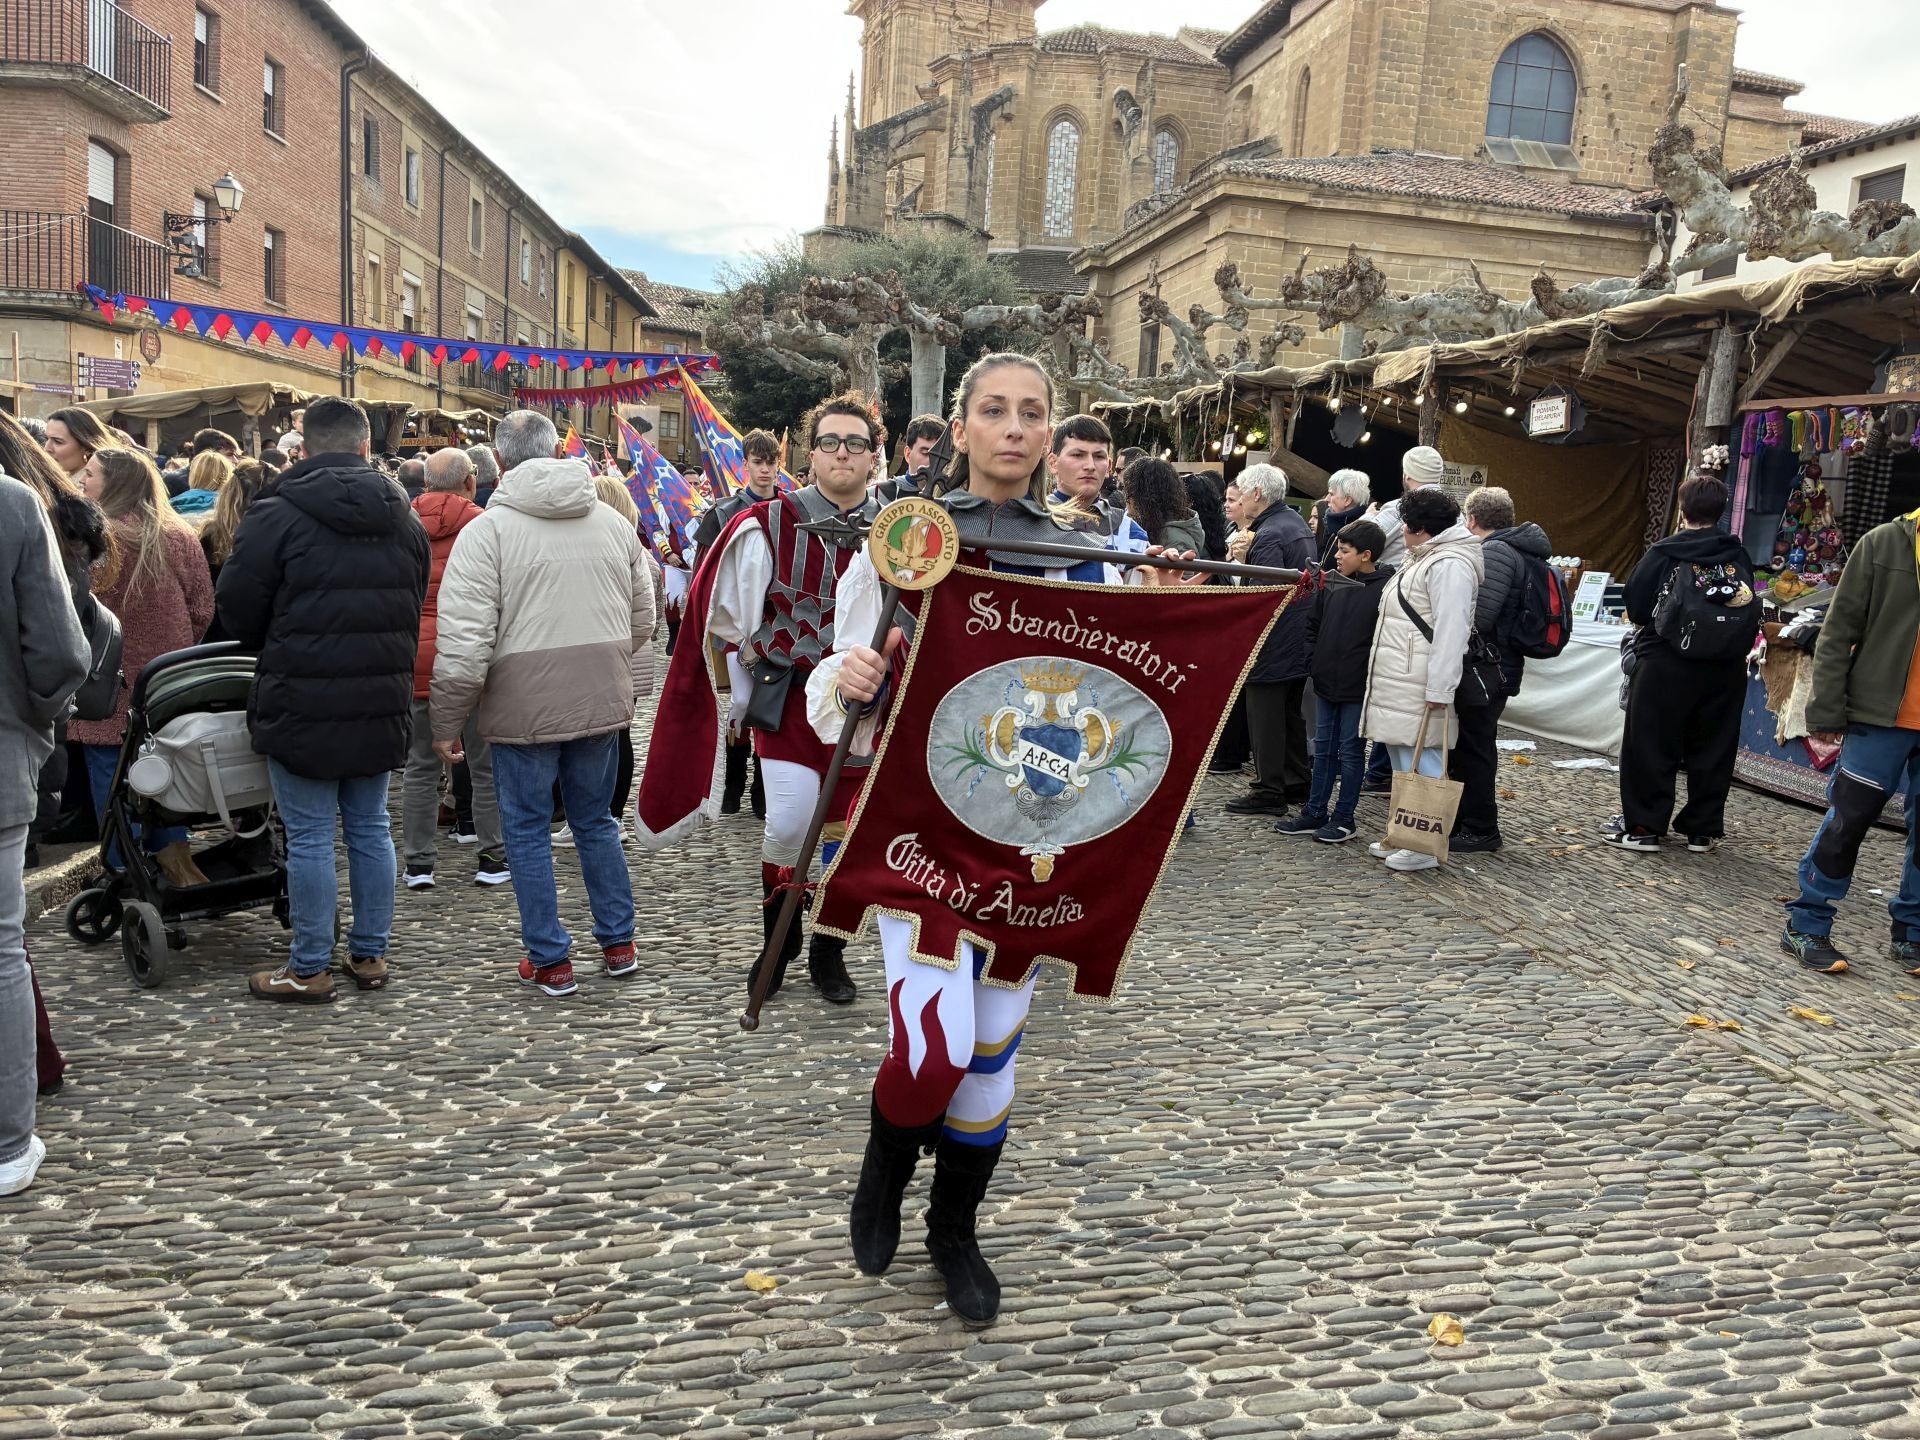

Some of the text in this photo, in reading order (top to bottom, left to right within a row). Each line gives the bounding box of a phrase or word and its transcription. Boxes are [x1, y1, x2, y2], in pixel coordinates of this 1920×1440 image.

[1537, 406, 1559, 414] POMADA
[875, 503, 954, 560] GRUPPO ASSOCIATO
[965, 590, 1198, 694] Sbandieratori
[1395, 808, 1443, 834] JUBA
[948, 872, 981, 912] di
[976, 880, 1085, 928] Amelia
